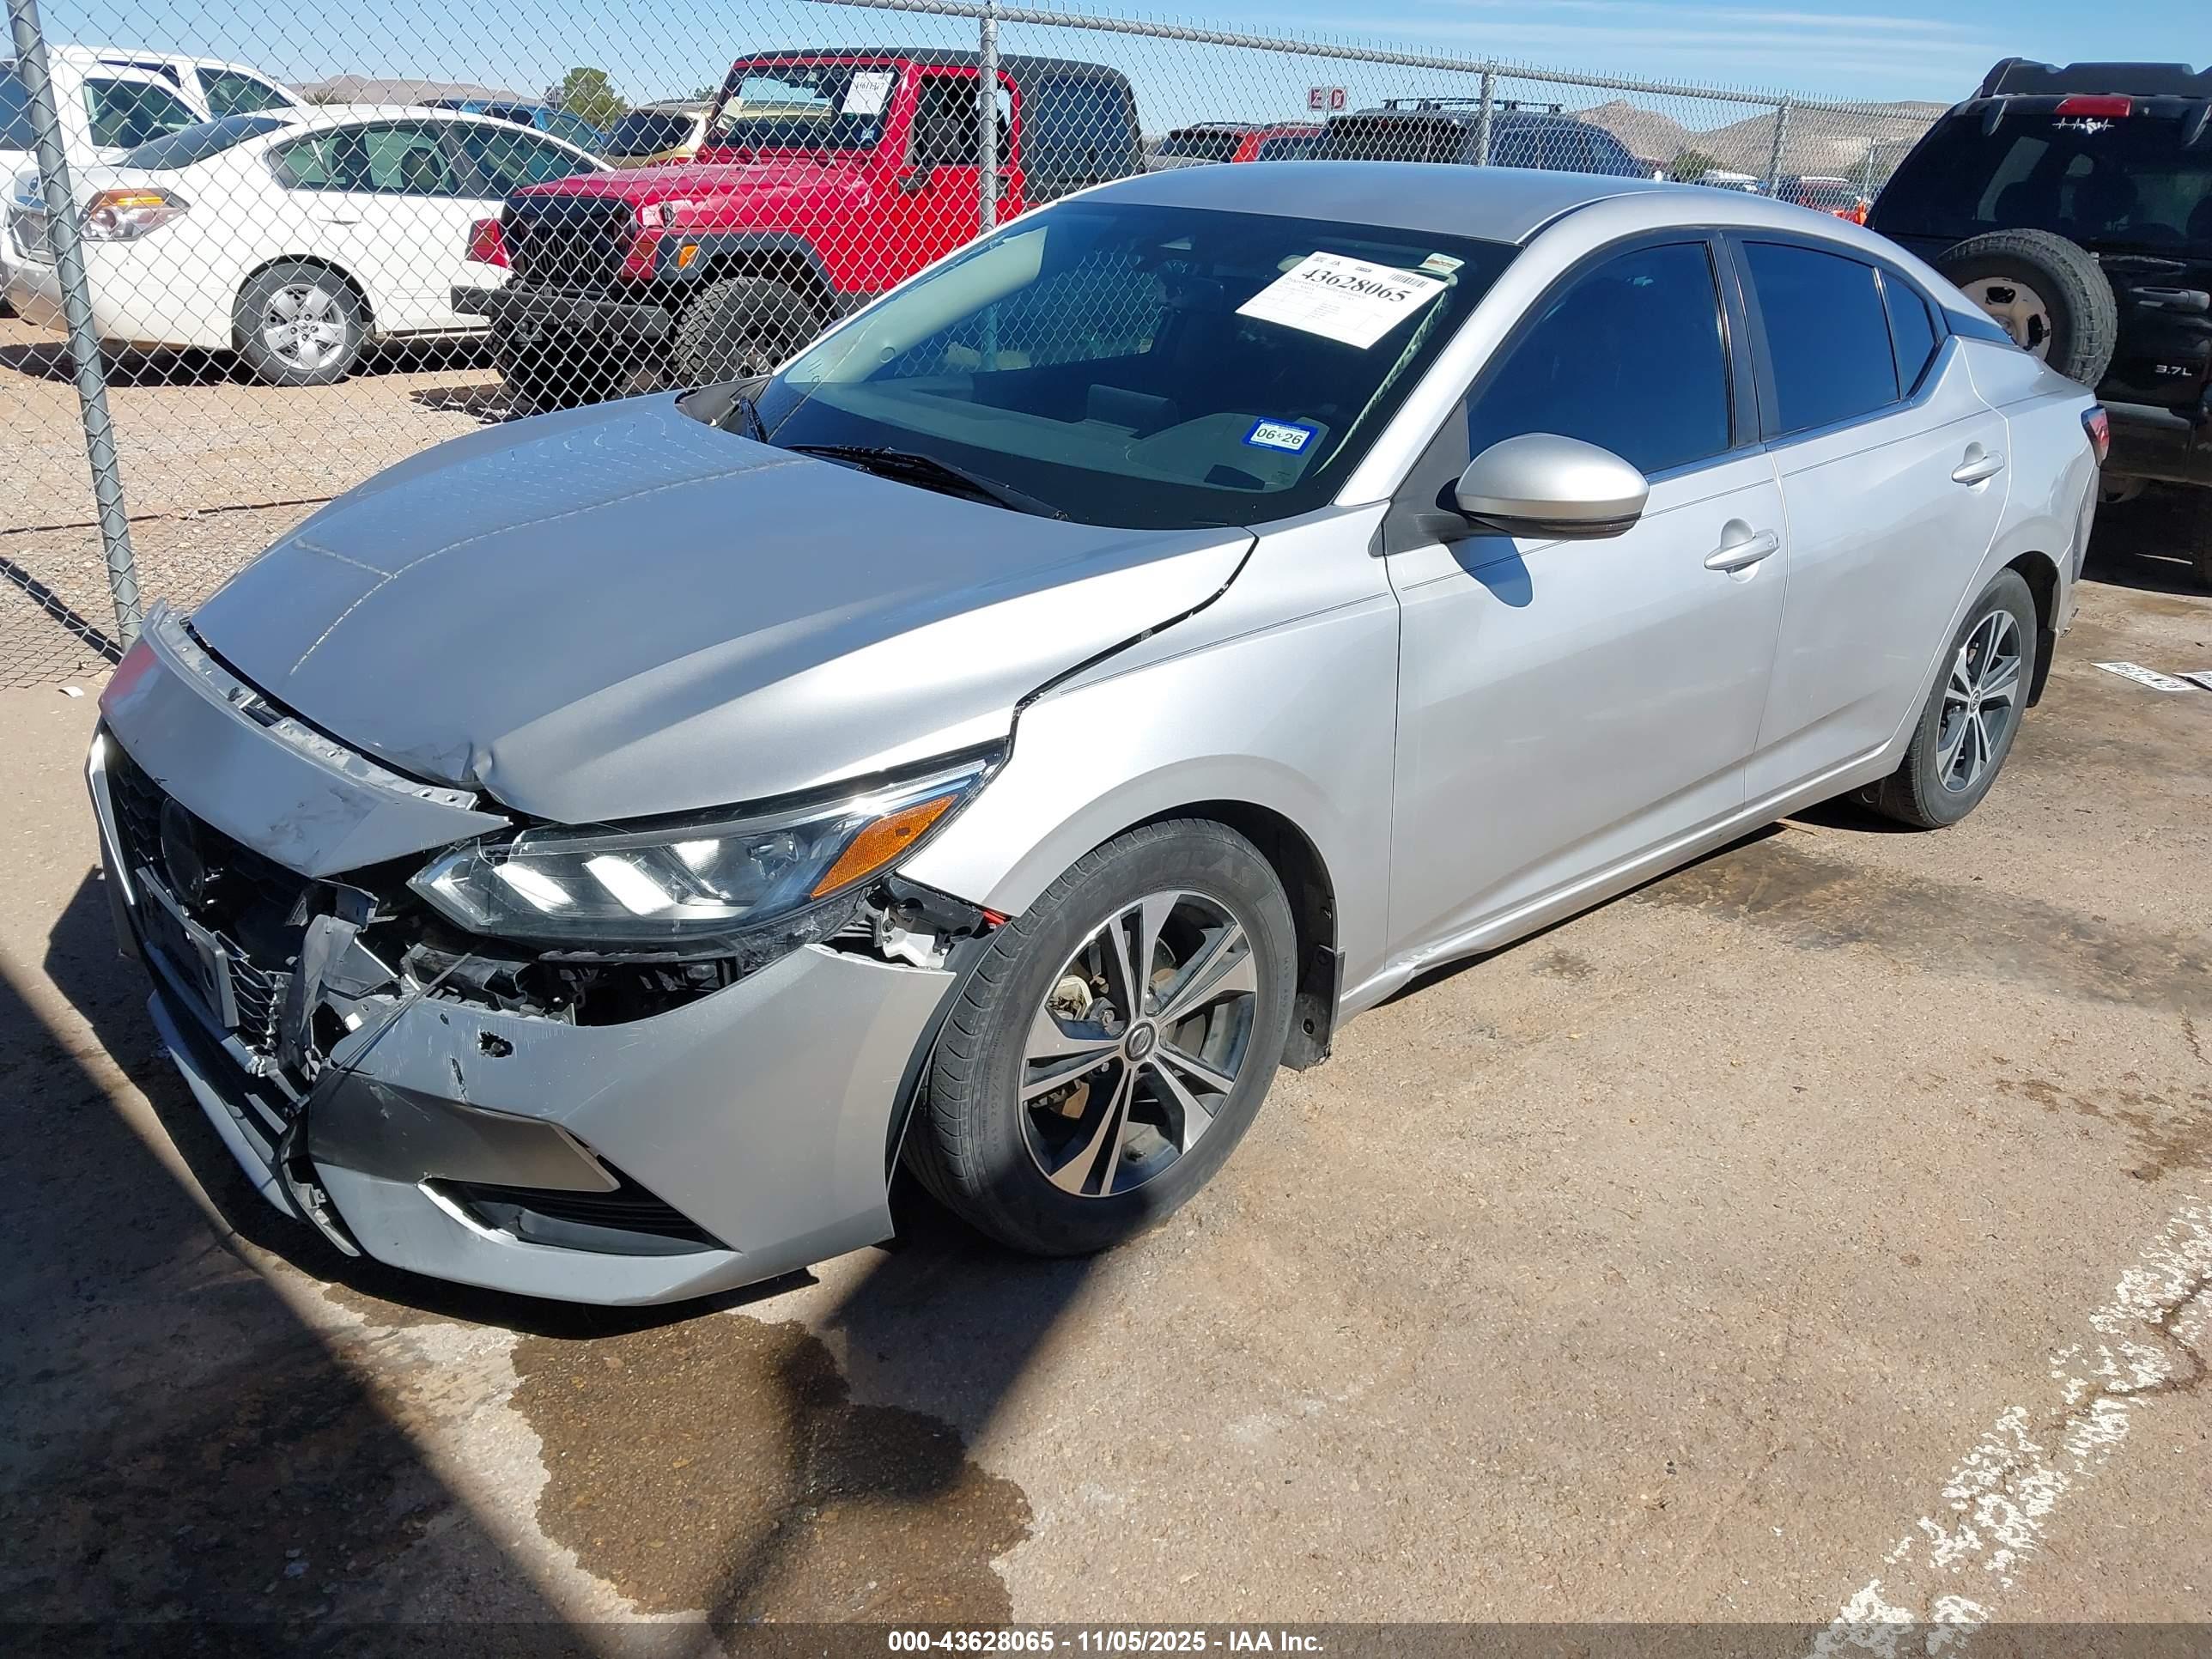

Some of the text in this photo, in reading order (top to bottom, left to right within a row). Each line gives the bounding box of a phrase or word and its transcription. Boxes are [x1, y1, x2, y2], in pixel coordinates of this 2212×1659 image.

[1310, 88, 1322, 109] E
[1331, 88, 1345, 109] D
[1301, 268, 1413, 302] 43628065
[2155, 364, 2192, 376] 3.7L
